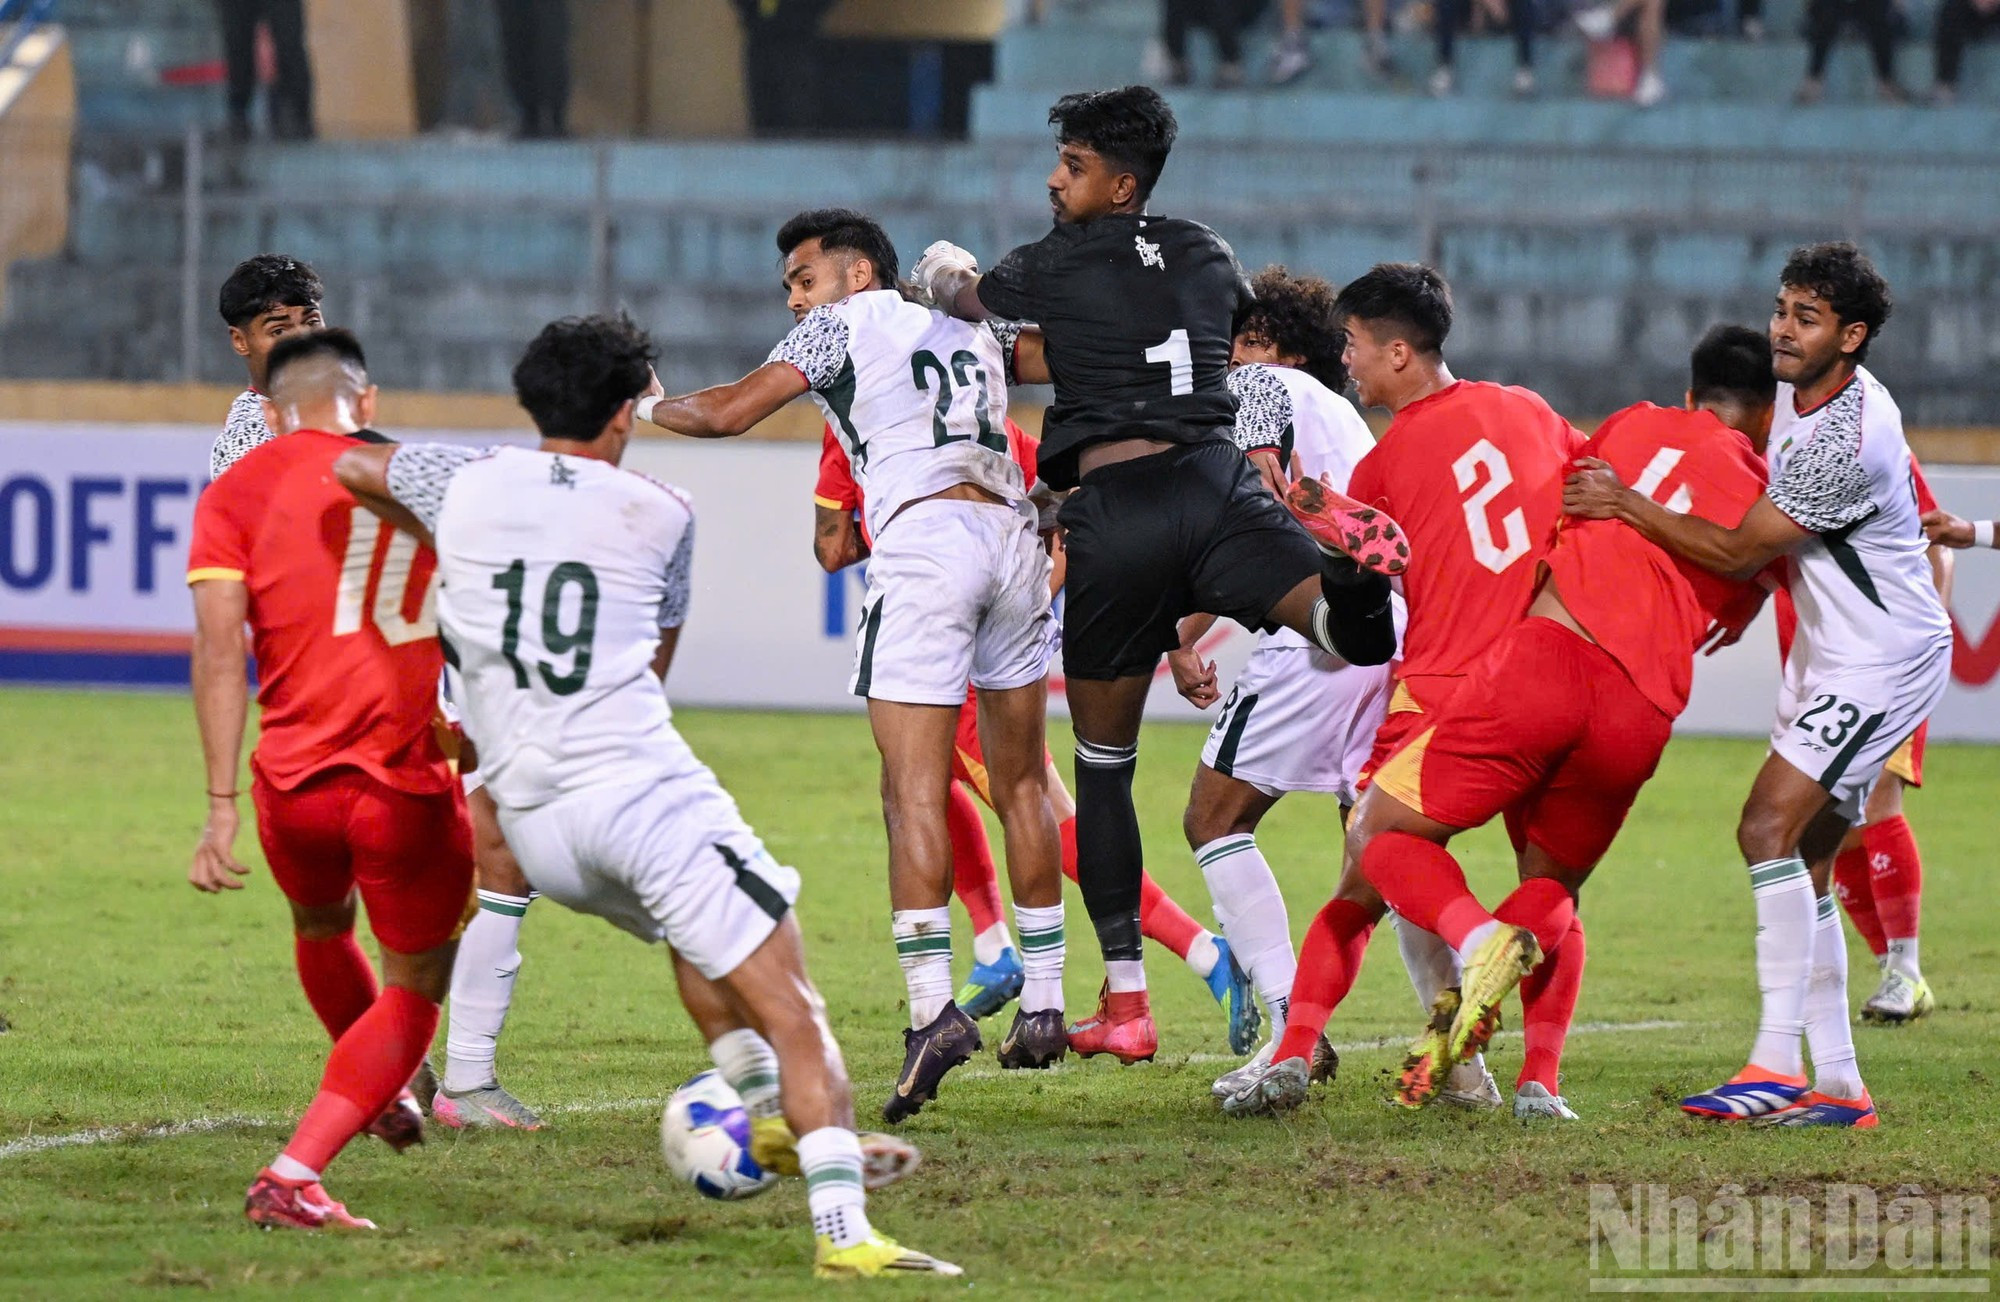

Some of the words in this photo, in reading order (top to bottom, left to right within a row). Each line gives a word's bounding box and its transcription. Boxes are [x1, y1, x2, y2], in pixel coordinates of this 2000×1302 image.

[911, 350, 1008, 453] 22
[1145, 329, 1193, 396] 1
[0, 474, 212, 592] OFF
[1451, 438, 1532, 574] 2
[332, 506, 440, 648] 10
[492, 558, 600, 696] 19
[1795, 694, 1860, 748] 23
